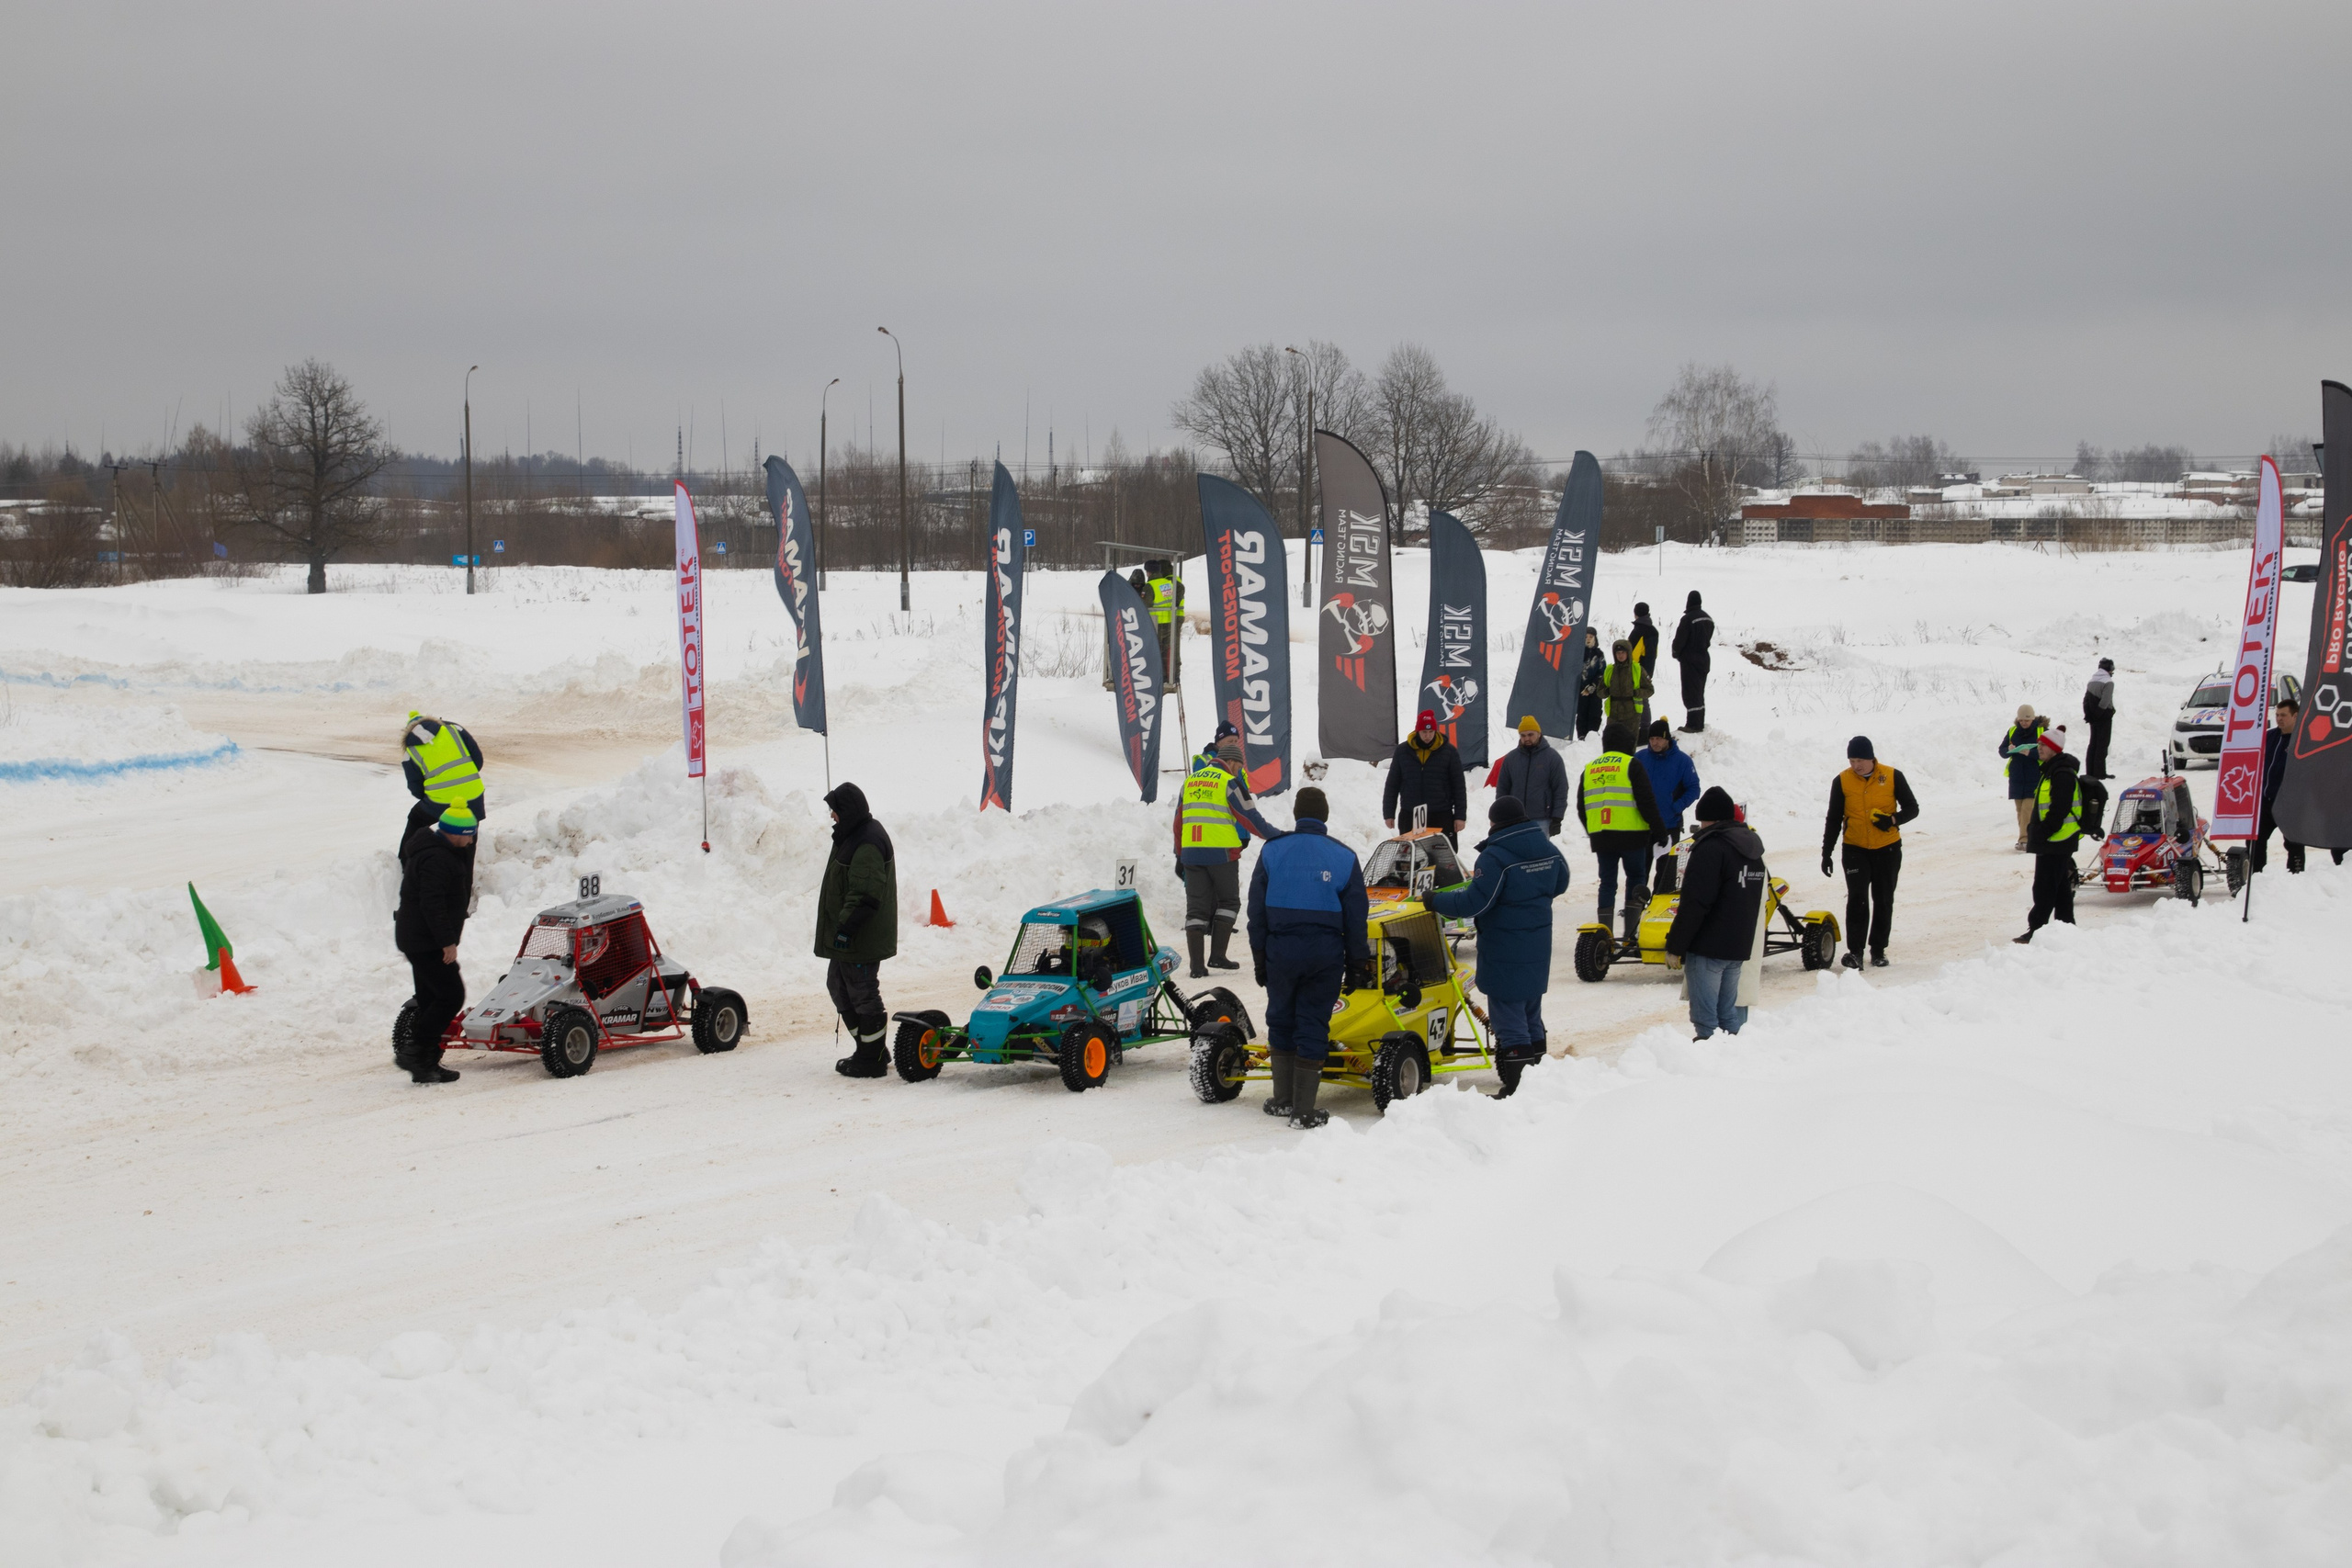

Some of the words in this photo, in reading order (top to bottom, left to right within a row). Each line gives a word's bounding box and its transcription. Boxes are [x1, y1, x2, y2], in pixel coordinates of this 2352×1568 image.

[1023, 530, 1034, 545] P
[680, 555, 699, 705] TOTEK
[2225, 551, 2275, 743] TOTEK
[1591, 756, 1623, 765] RUSTA
[1191, 771, 1222, 779] RUSTA
[1589, 765, 1621, 774] МАРШАЛ
[1187, 780, 1219, 789] МАРШАЛ
[1414, 807, 1426, 829] 10
[1118, 865, 1135, 886] 31
[1417, 873, 1433, 893] 43
[580, 874, 600, 899] 88
[1129, 972, 1148, 985] Иван
[602, 1013, 638, 1025] KRAMAR
[1429, 1017, 1446, 1041] 43
